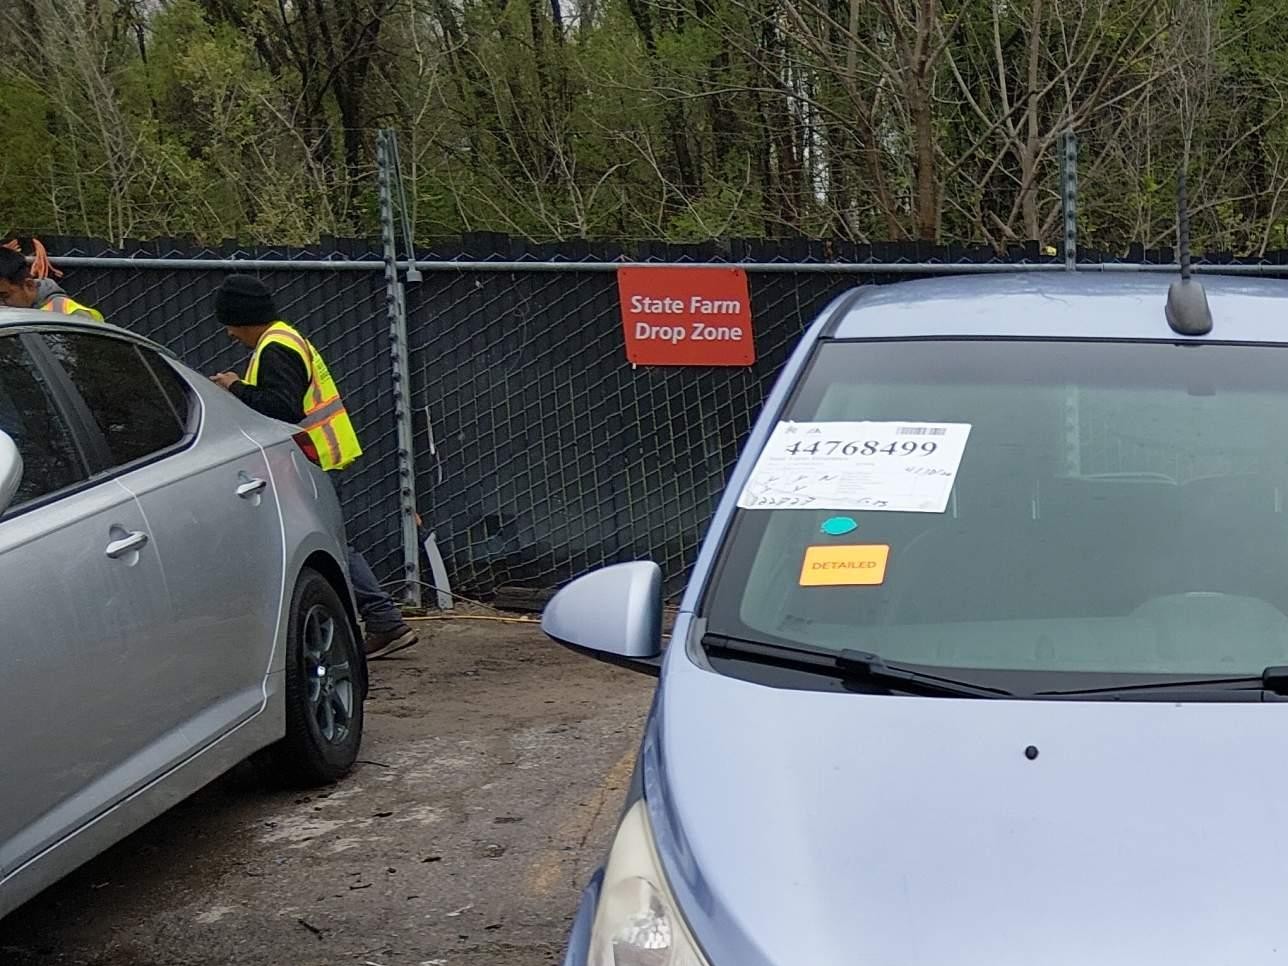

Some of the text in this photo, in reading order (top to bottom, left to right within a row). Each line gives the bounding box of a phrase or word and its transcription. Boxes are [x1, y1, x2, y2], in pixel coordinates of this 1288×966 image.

[630, 296, 740, 314] State Farm
[635, 322, 742, 344] Drop Zone
[785, 440, 937, 456] 44768499
[811, 561, 876, 570] DETAILED
